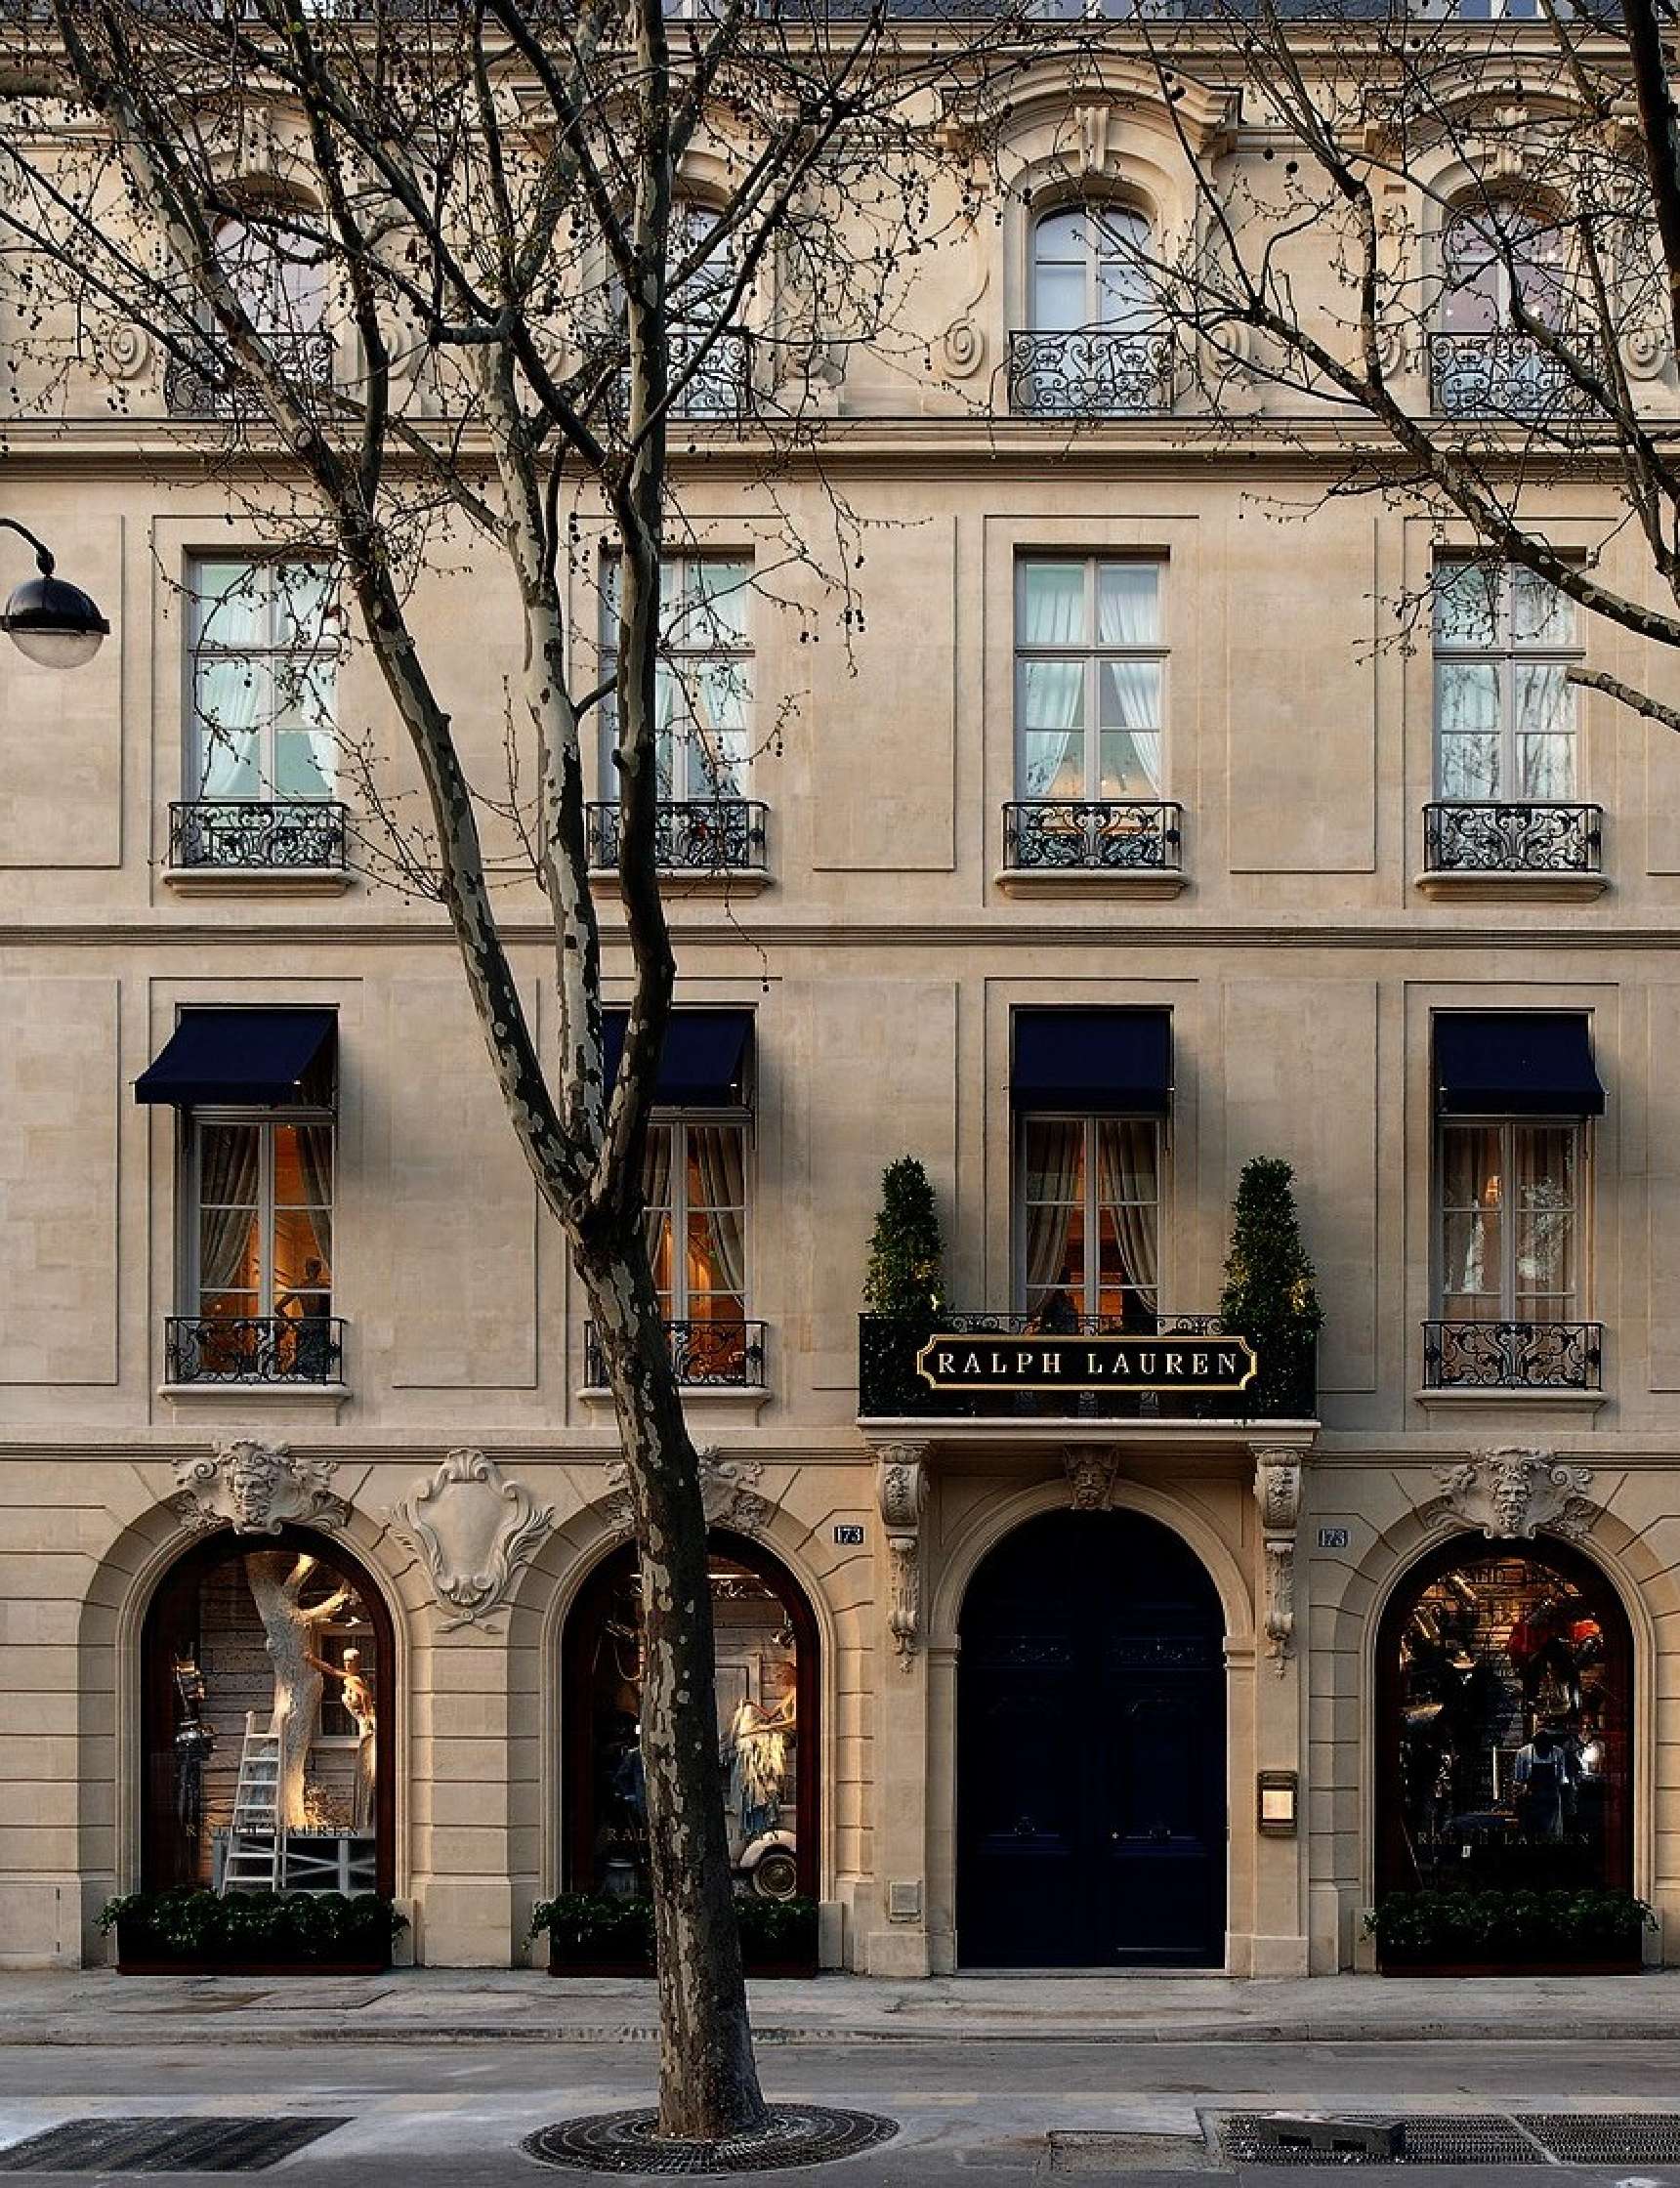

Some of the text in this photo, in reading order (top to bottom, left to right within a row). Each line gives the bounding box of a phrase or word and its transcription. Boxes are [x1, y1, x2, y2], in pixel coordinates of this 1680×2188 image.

[938, 1353, 1237, 1374] RALPH LAUREN
[837, 1528, 861, 1543] 173
[607, 1829, 650, 1841] RAL
